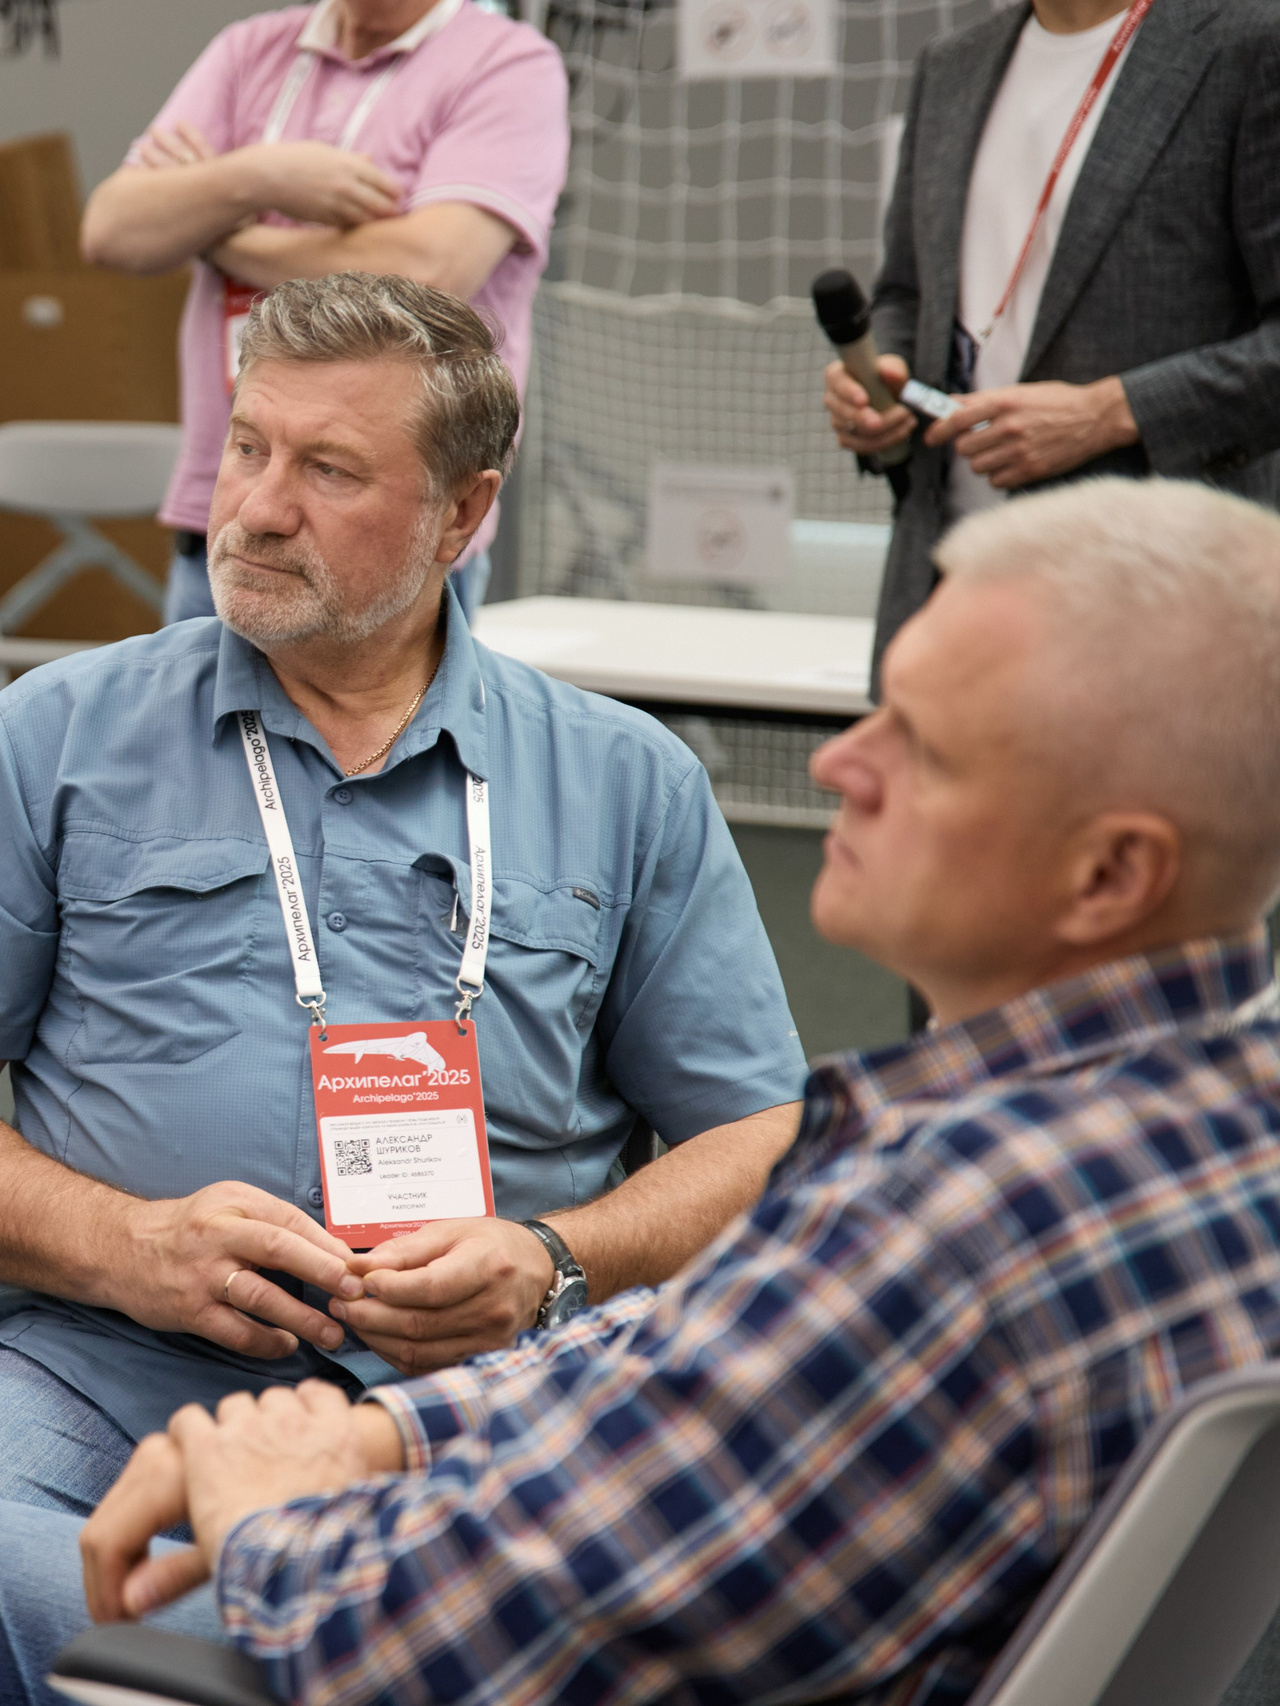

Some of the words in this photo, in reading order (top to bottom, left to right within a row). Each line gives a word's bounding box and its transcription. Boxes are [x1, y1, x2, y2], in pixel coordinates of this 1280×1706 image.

[376, 1133, 433, 1145] АЛЕКСАНДР
[376, 1144, 421, 1155] ШУРИКОВ
[387, 1192, 428, 1200] УЧАСТНИК
